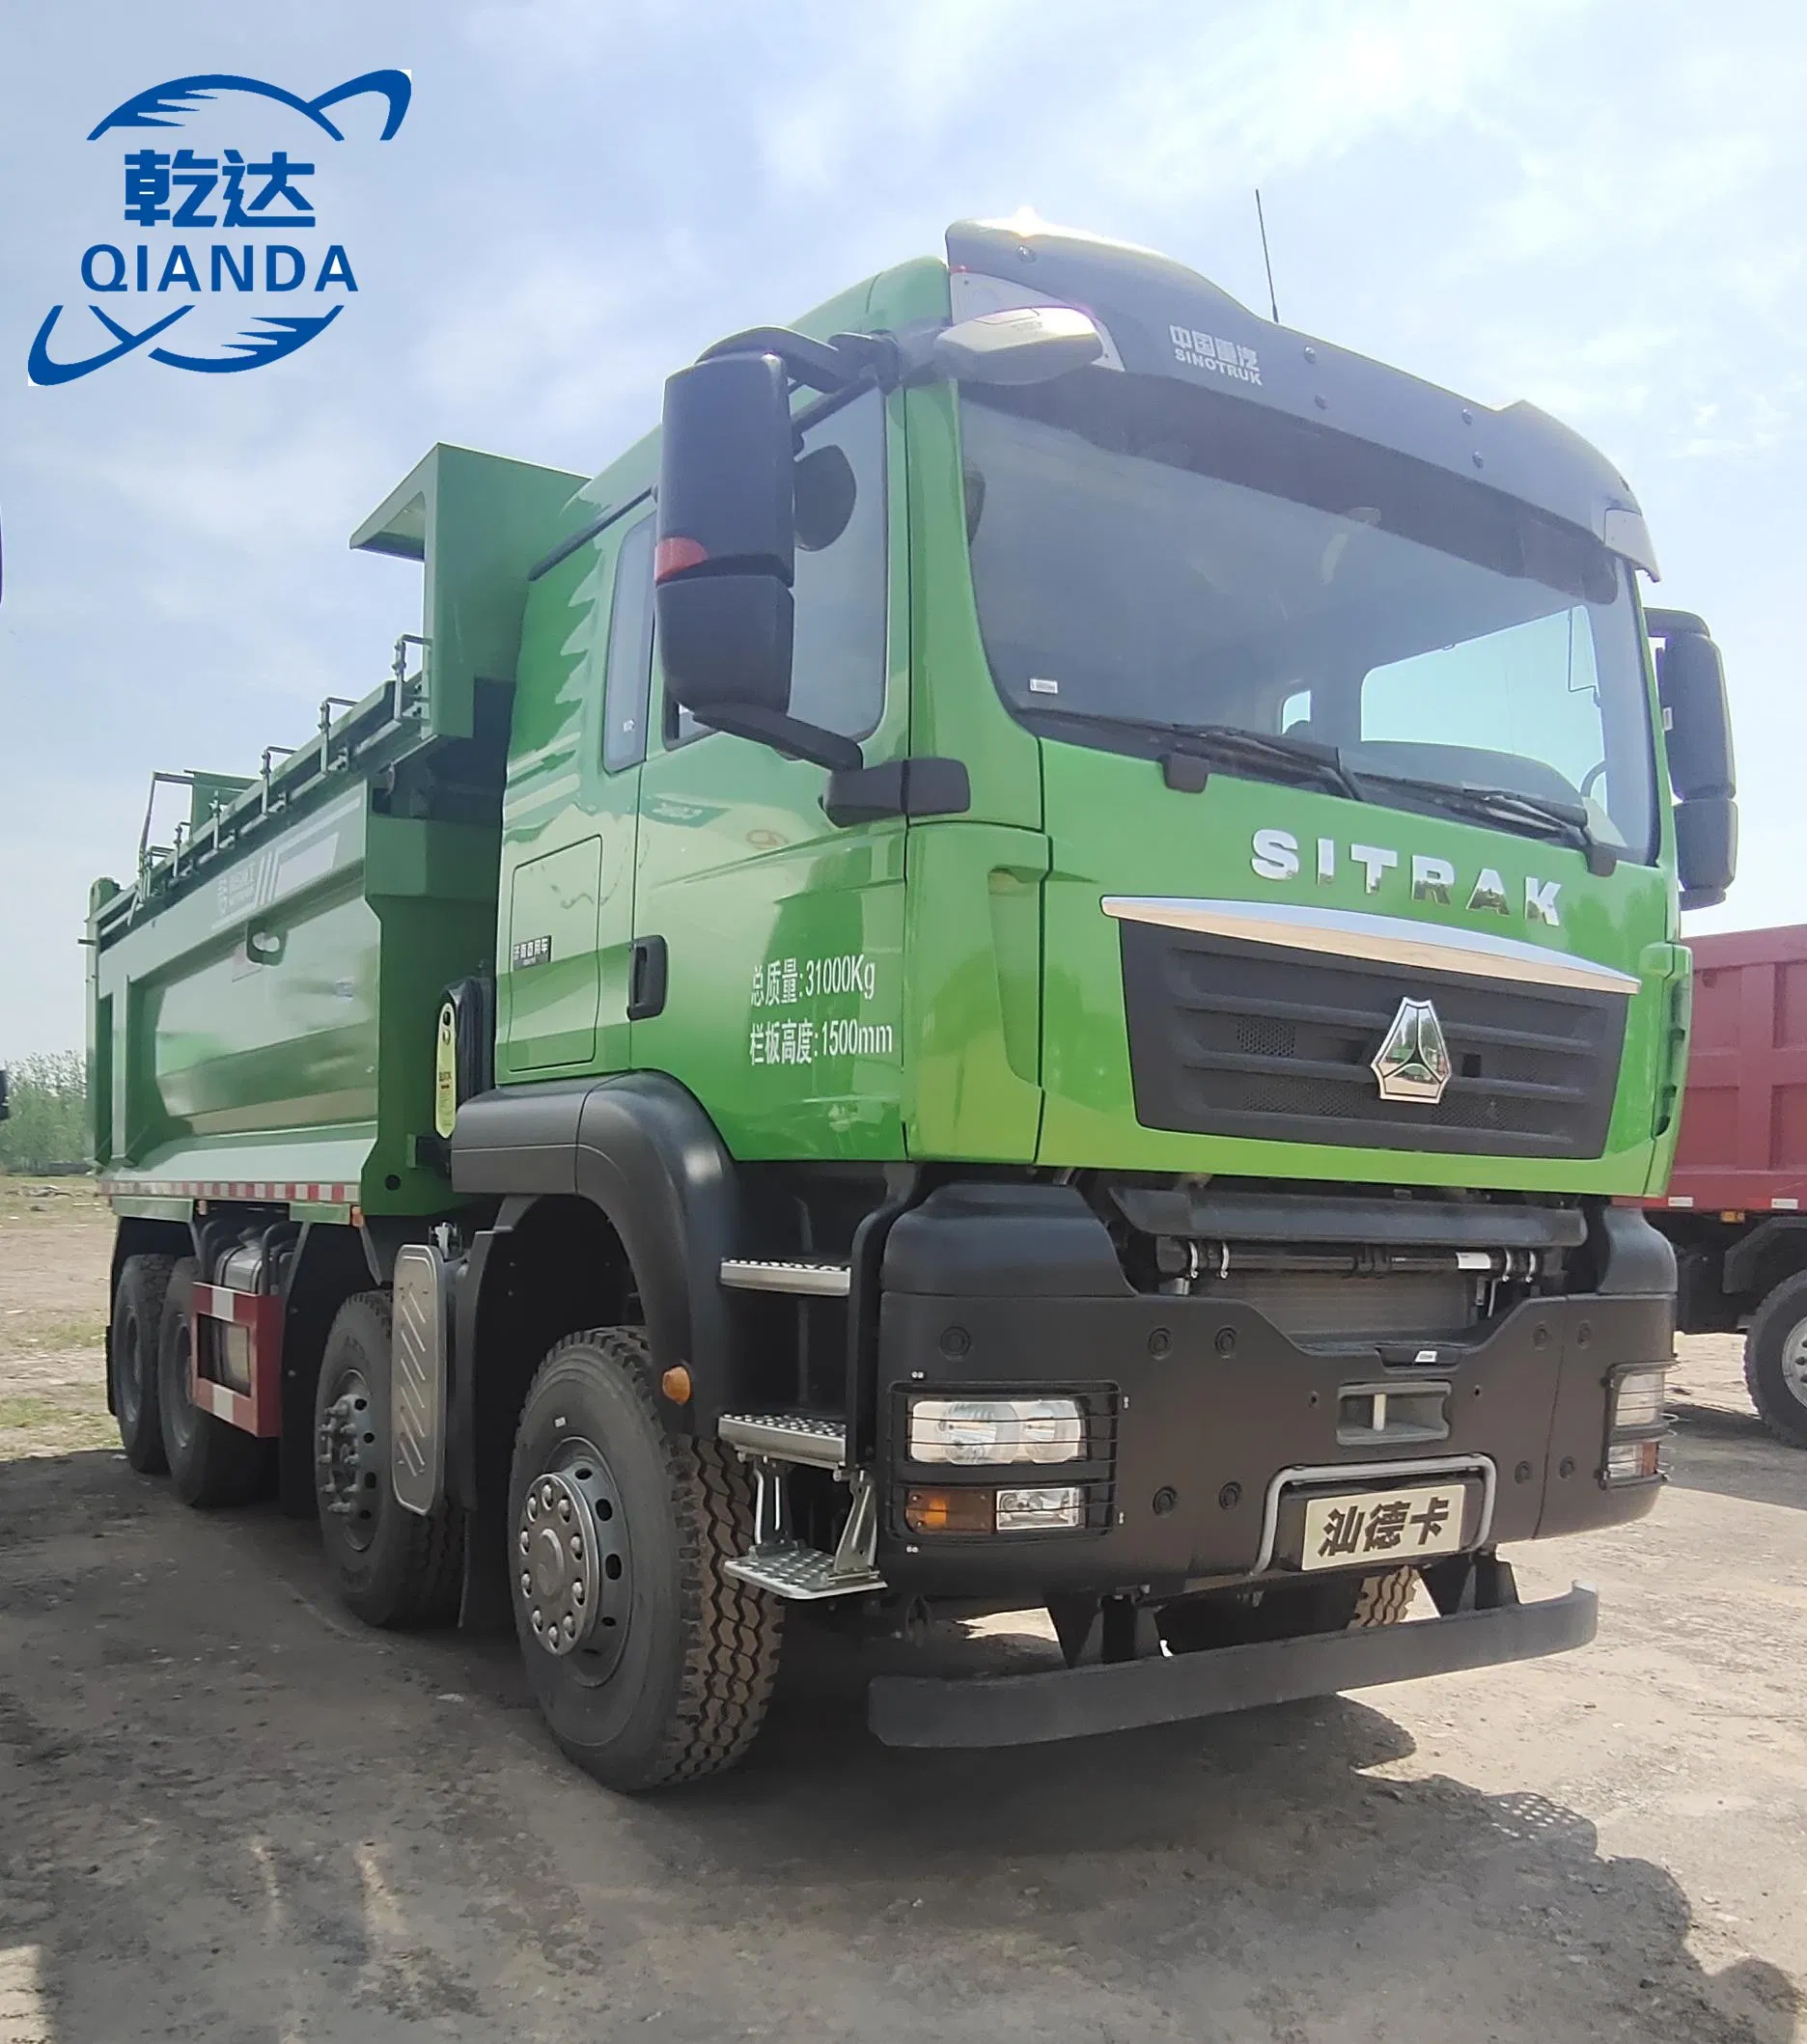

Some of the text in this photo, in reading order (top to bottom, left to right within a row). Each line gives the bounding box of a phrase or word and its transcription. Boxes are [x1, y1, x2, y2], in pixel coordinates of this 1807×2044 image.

[1174, 347, 1263, 386] SINOTRUK
[1250, 828, 1562, 927] SITRAK
[1317, 1496, 1450, 1558] 汕德卡
